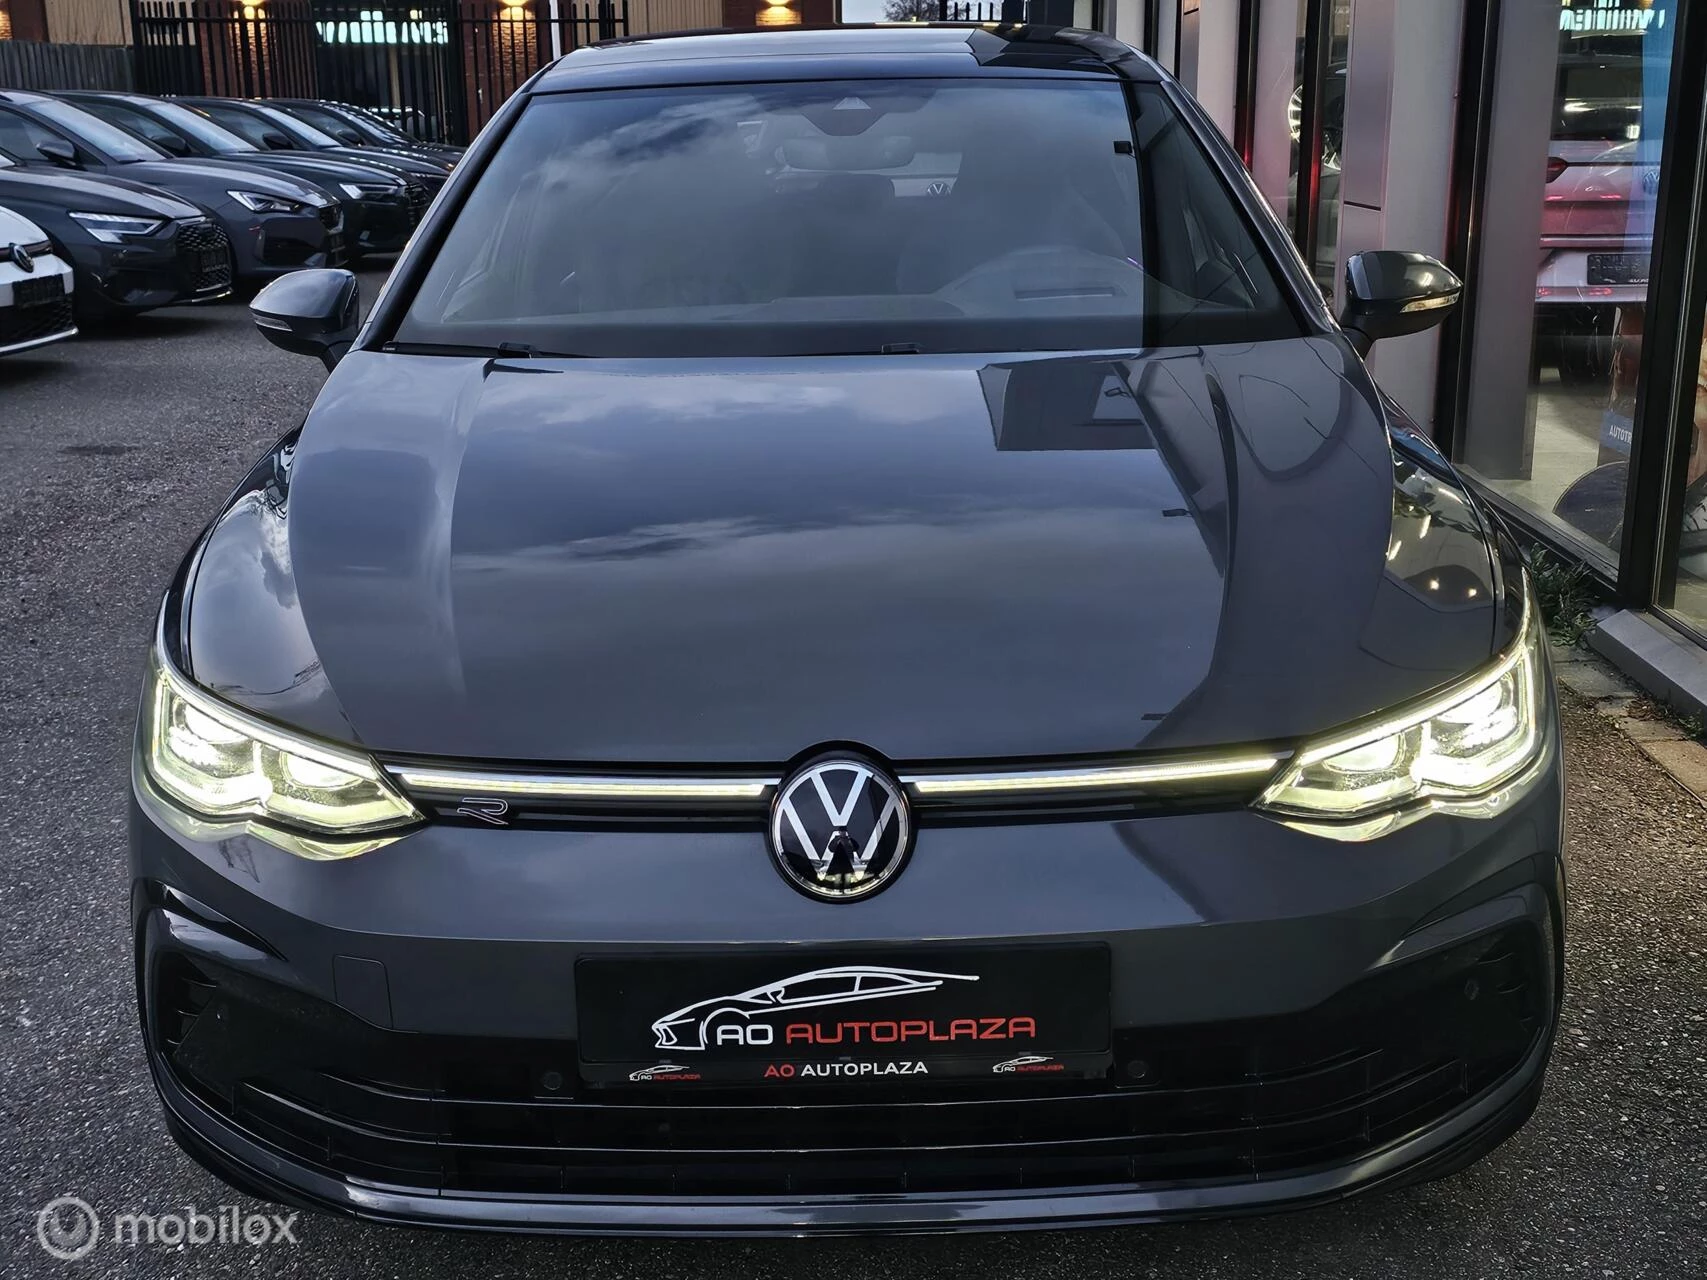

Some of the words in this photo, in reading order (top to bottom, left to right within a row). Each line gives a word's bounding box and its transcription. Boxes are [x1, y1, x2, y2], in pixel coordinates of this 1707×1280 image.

[716, 1024, 774, 1045] AO
[786, 1016, 1036, 1044] AUTOPLAZA
[763, 1063, 796, 1078] AO
[800, 1060, 929, 1077] AUTOPLAZA
